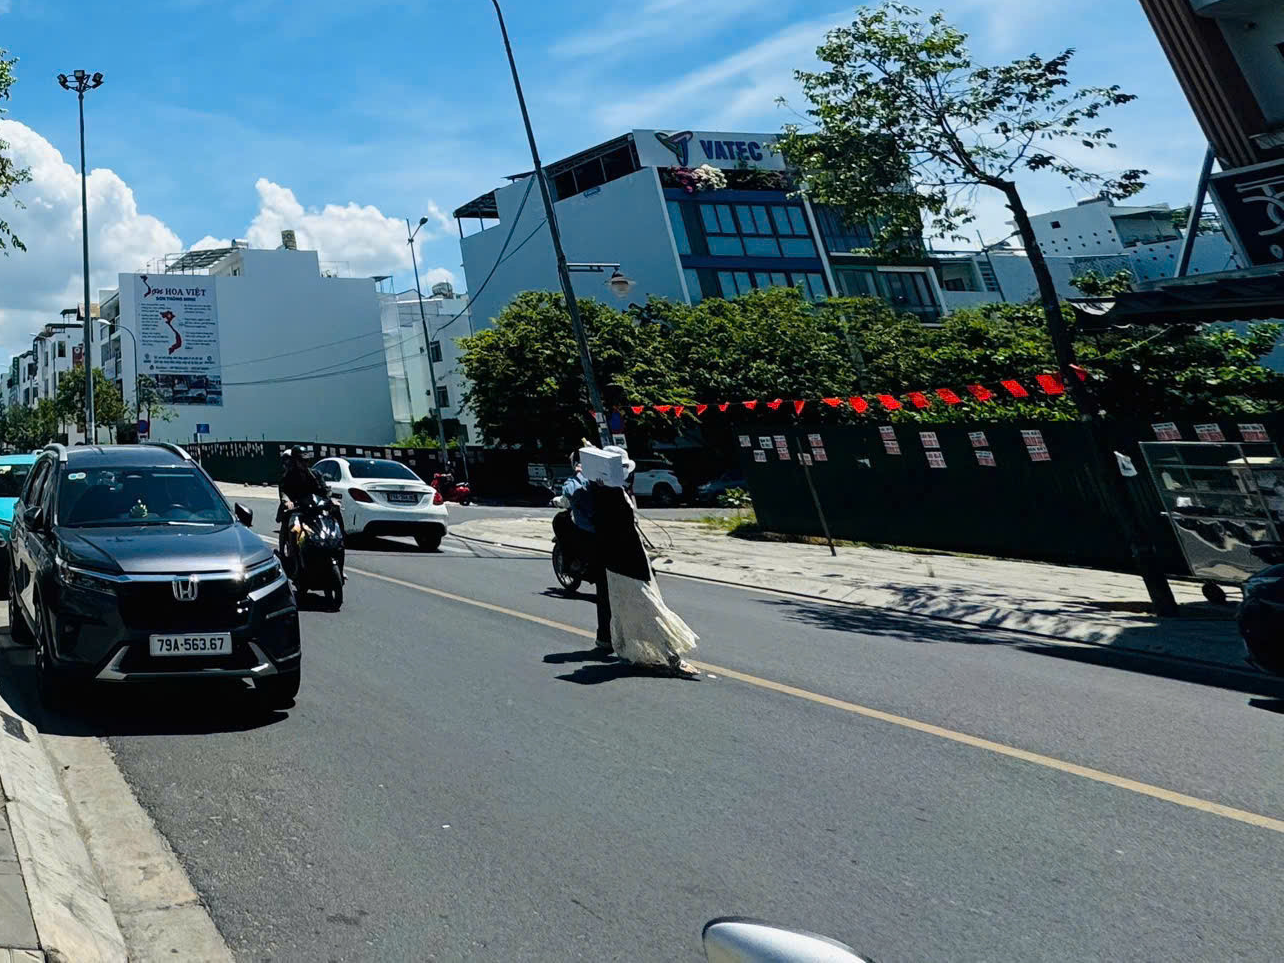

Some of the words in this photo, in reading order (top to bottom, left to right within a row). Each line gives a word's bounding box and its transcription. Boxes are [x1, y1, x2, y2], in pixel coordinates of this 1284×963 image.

[699, 139, 764, 161] VATEC
[165, 287, 184, 296] HOA
[185, 286, 206, 297] VIỆT
